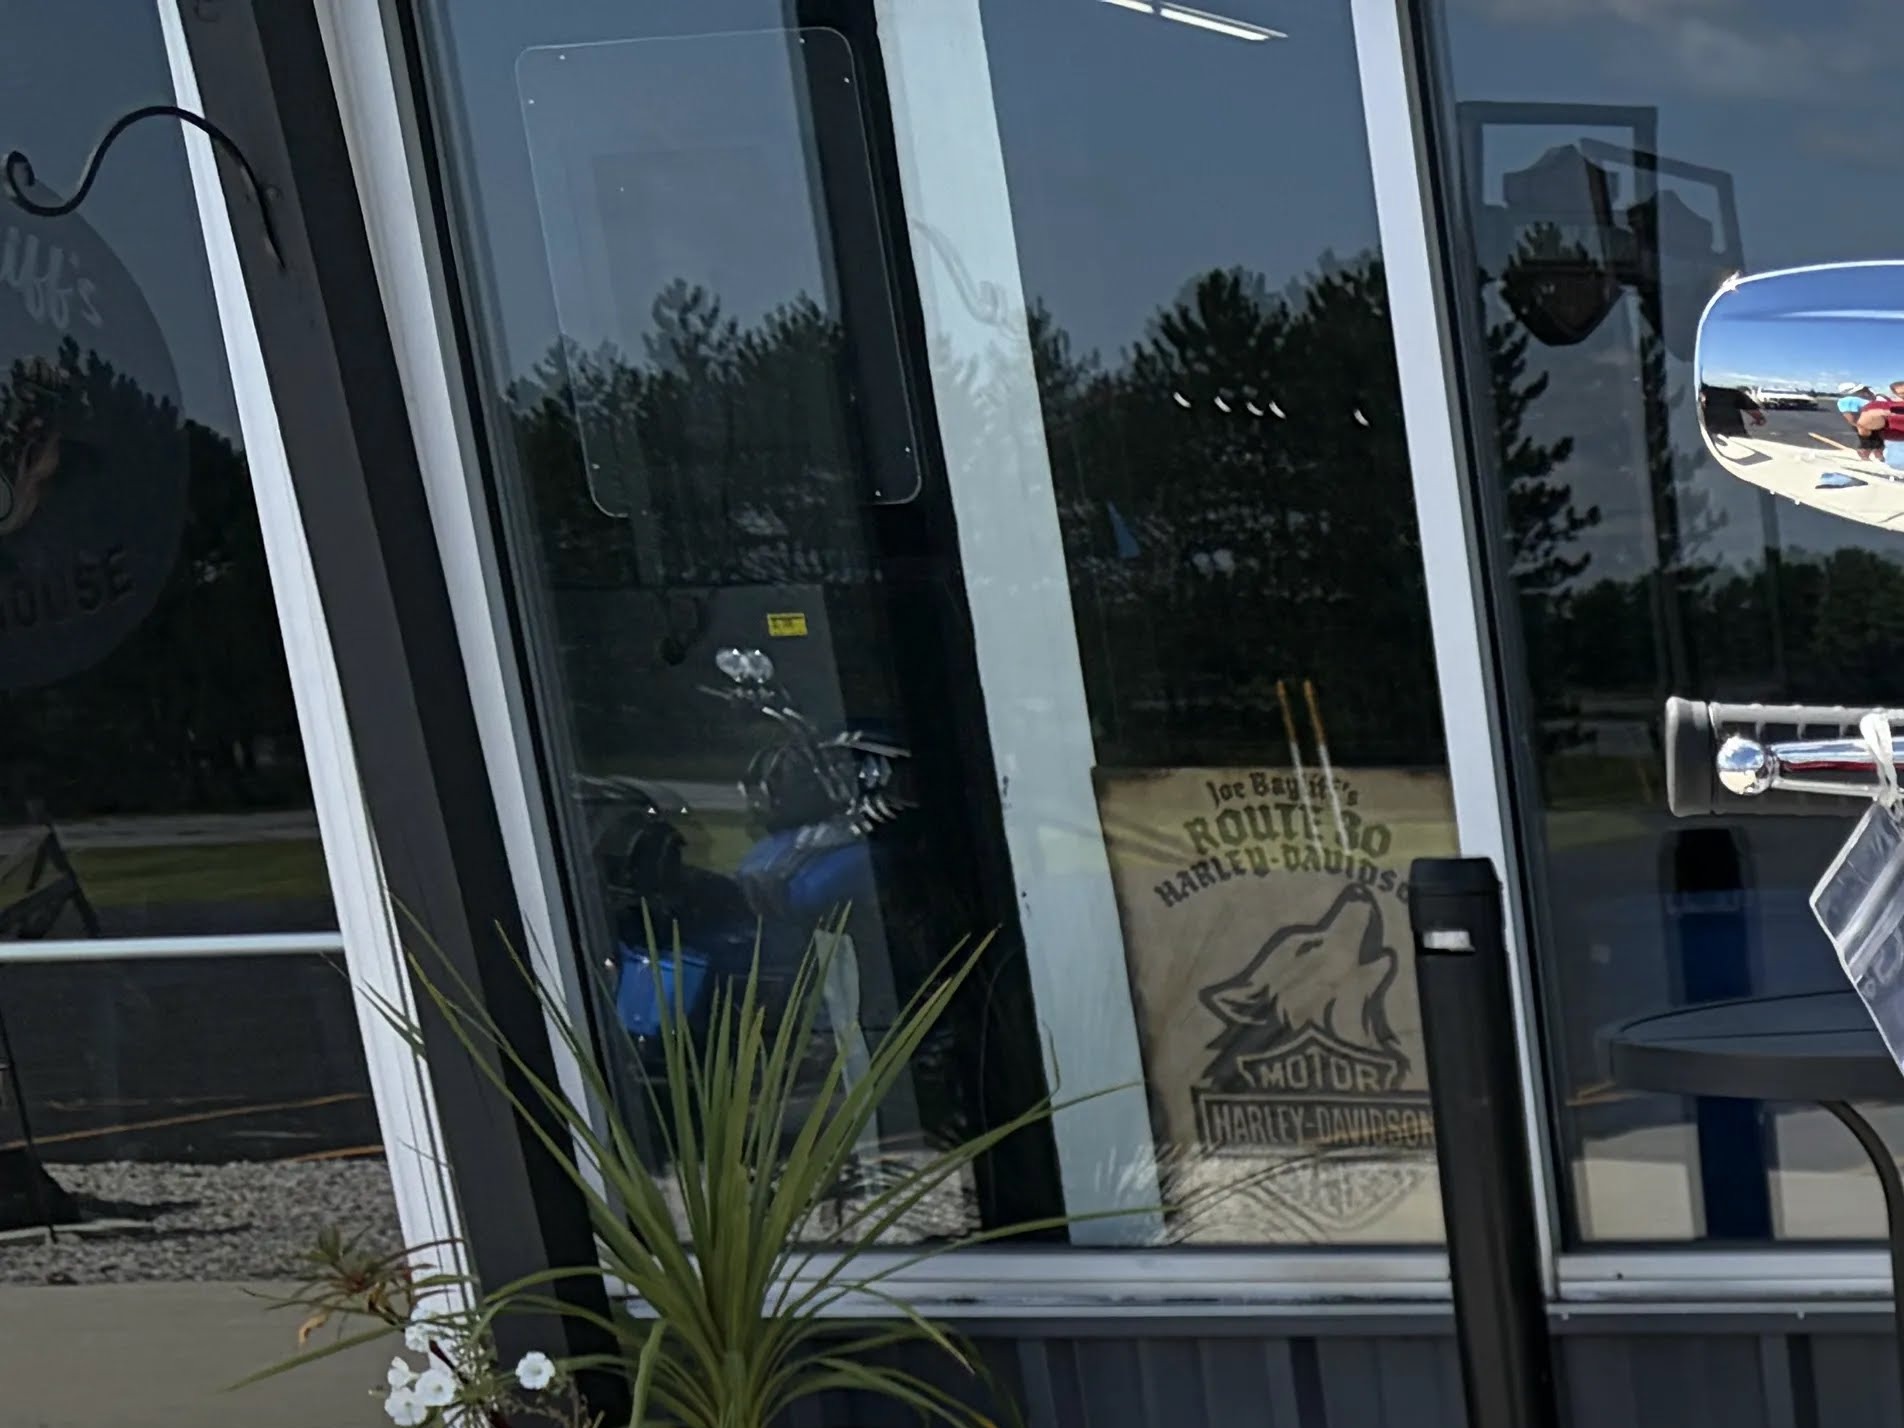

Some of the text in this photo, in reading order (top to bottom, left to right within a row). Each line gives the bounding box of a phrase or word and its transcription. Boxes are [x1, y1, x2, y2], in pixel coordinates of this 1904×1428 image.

[0, 543, 136, 632] OUSE
[1206, 771, 1359, 808] Joe Bayif's
[1183, 802, 1325, 856] ROUTE
[1152, 844, 1410, 908] HARLEY-DAVIDSO
[1258, 1046, 1382, 1093] MOTOR
[1212, 1101, 1436, 1148] HARLEY-DAVIDSON
